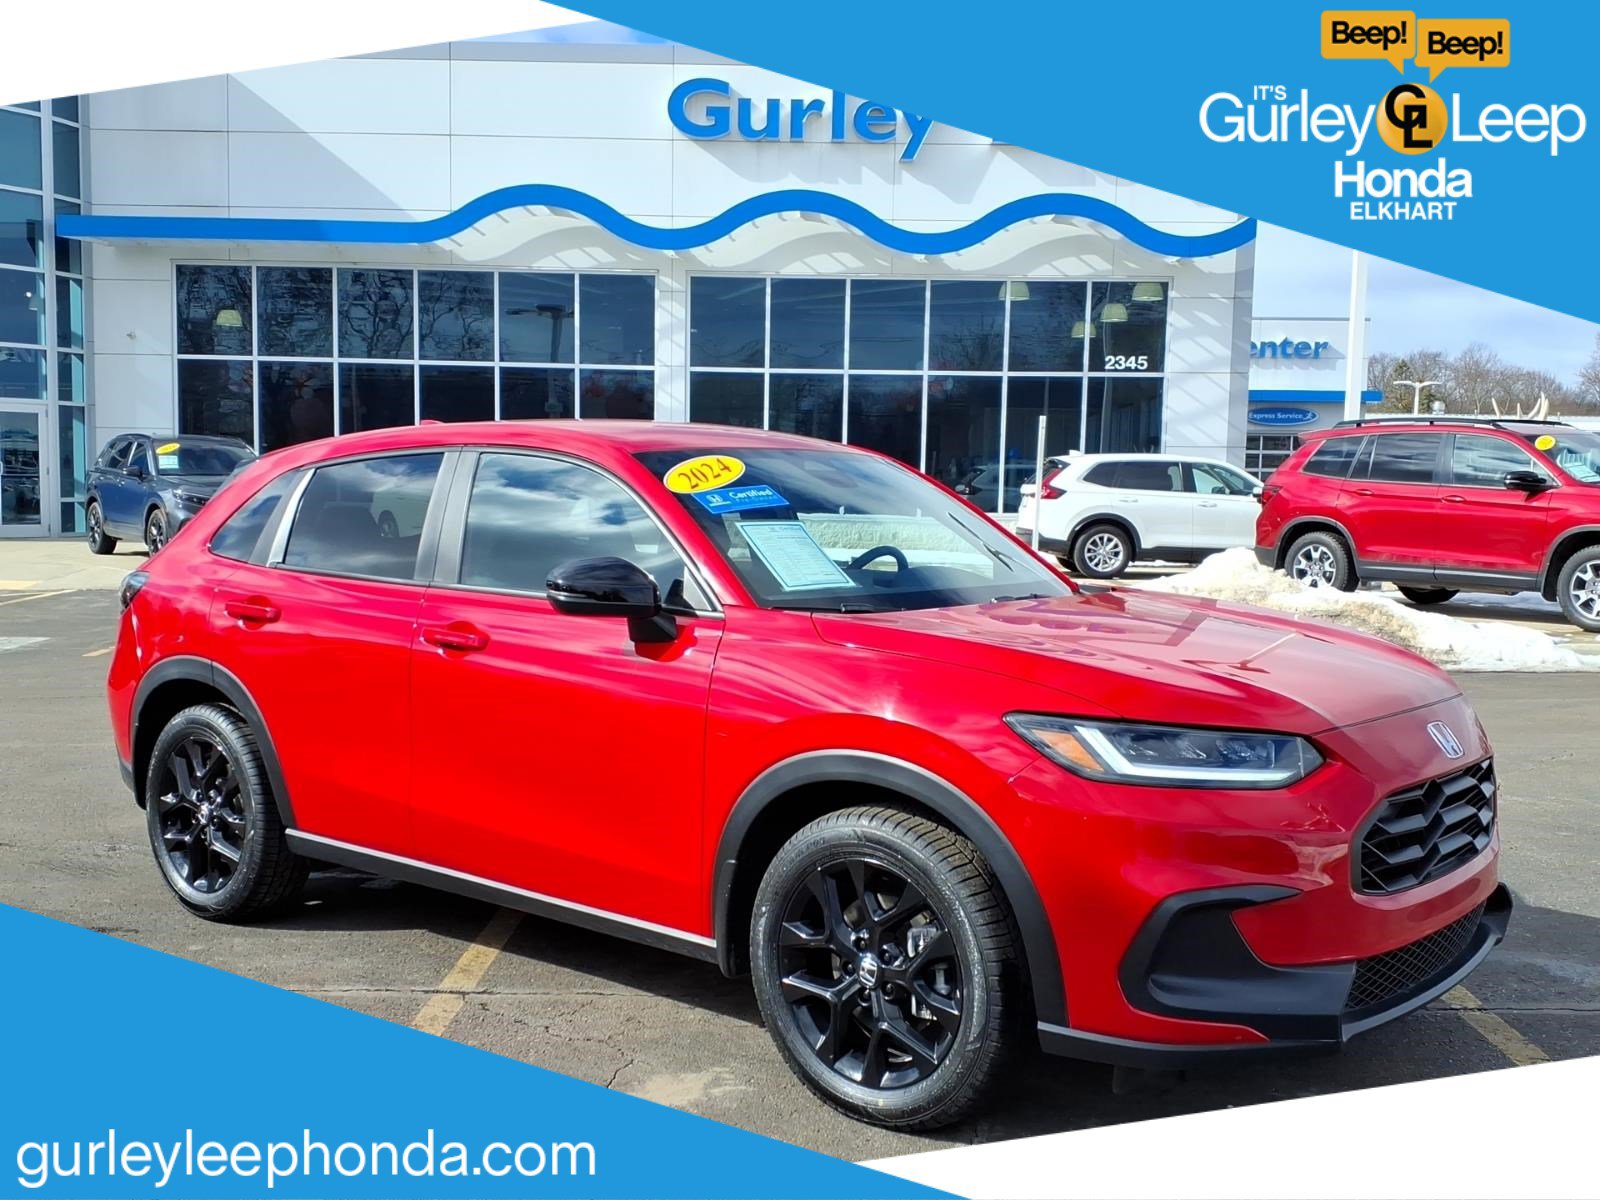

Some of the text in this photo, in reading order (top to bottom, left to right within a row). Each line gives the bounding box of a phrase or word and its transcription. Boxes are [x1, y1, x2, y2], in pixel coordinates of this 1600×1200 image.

[668, 78, 934, 163] Gurley
[1104, 355, 1149, 370] 2345
[1277, 411, 1304, 420] Service
[678, 457, 732, 489] 2024
[729, 489, 773, 499] Certified
